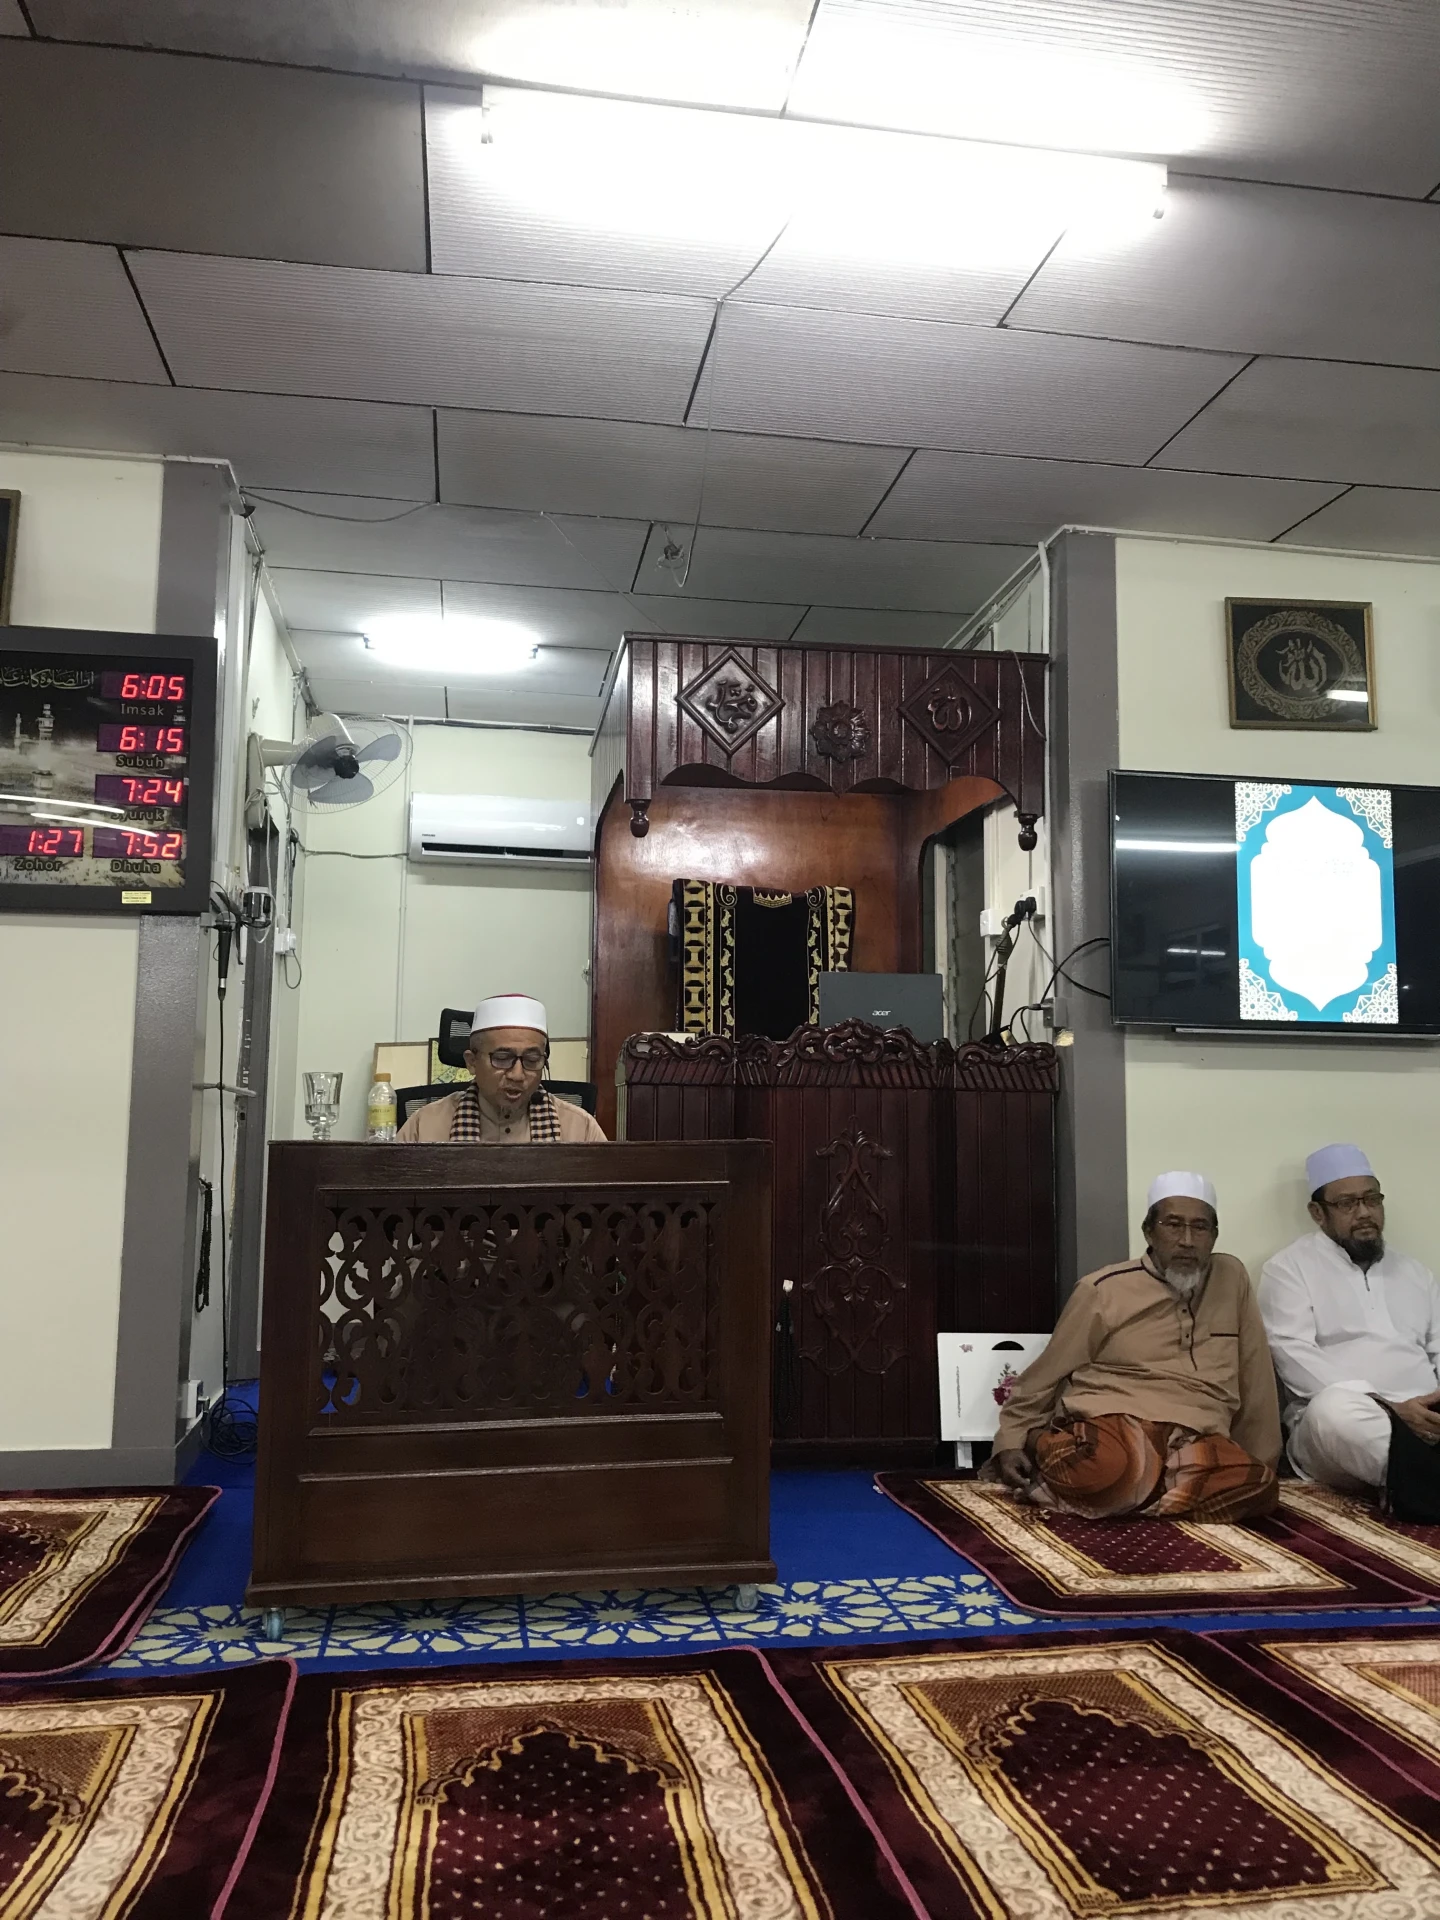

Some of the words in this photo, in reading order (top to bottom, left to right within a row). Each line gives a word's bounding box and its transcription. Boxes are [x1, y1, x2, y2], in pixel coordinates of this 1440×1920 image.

[121, 674, 185, 700] 6:05
[121, 703, 165, 716] Imsak
[119, 726, 184, 752] 6:15
[116, 754, 165, 768] Subuh
[121, 779, 182, 804] 7:24
[28, 829, 83, 854] 1:27
[120, 832, 182, 858] 7:52
[16, 857, 62, 870] Zohor
[112, 861, 161, 874] Dhuha
